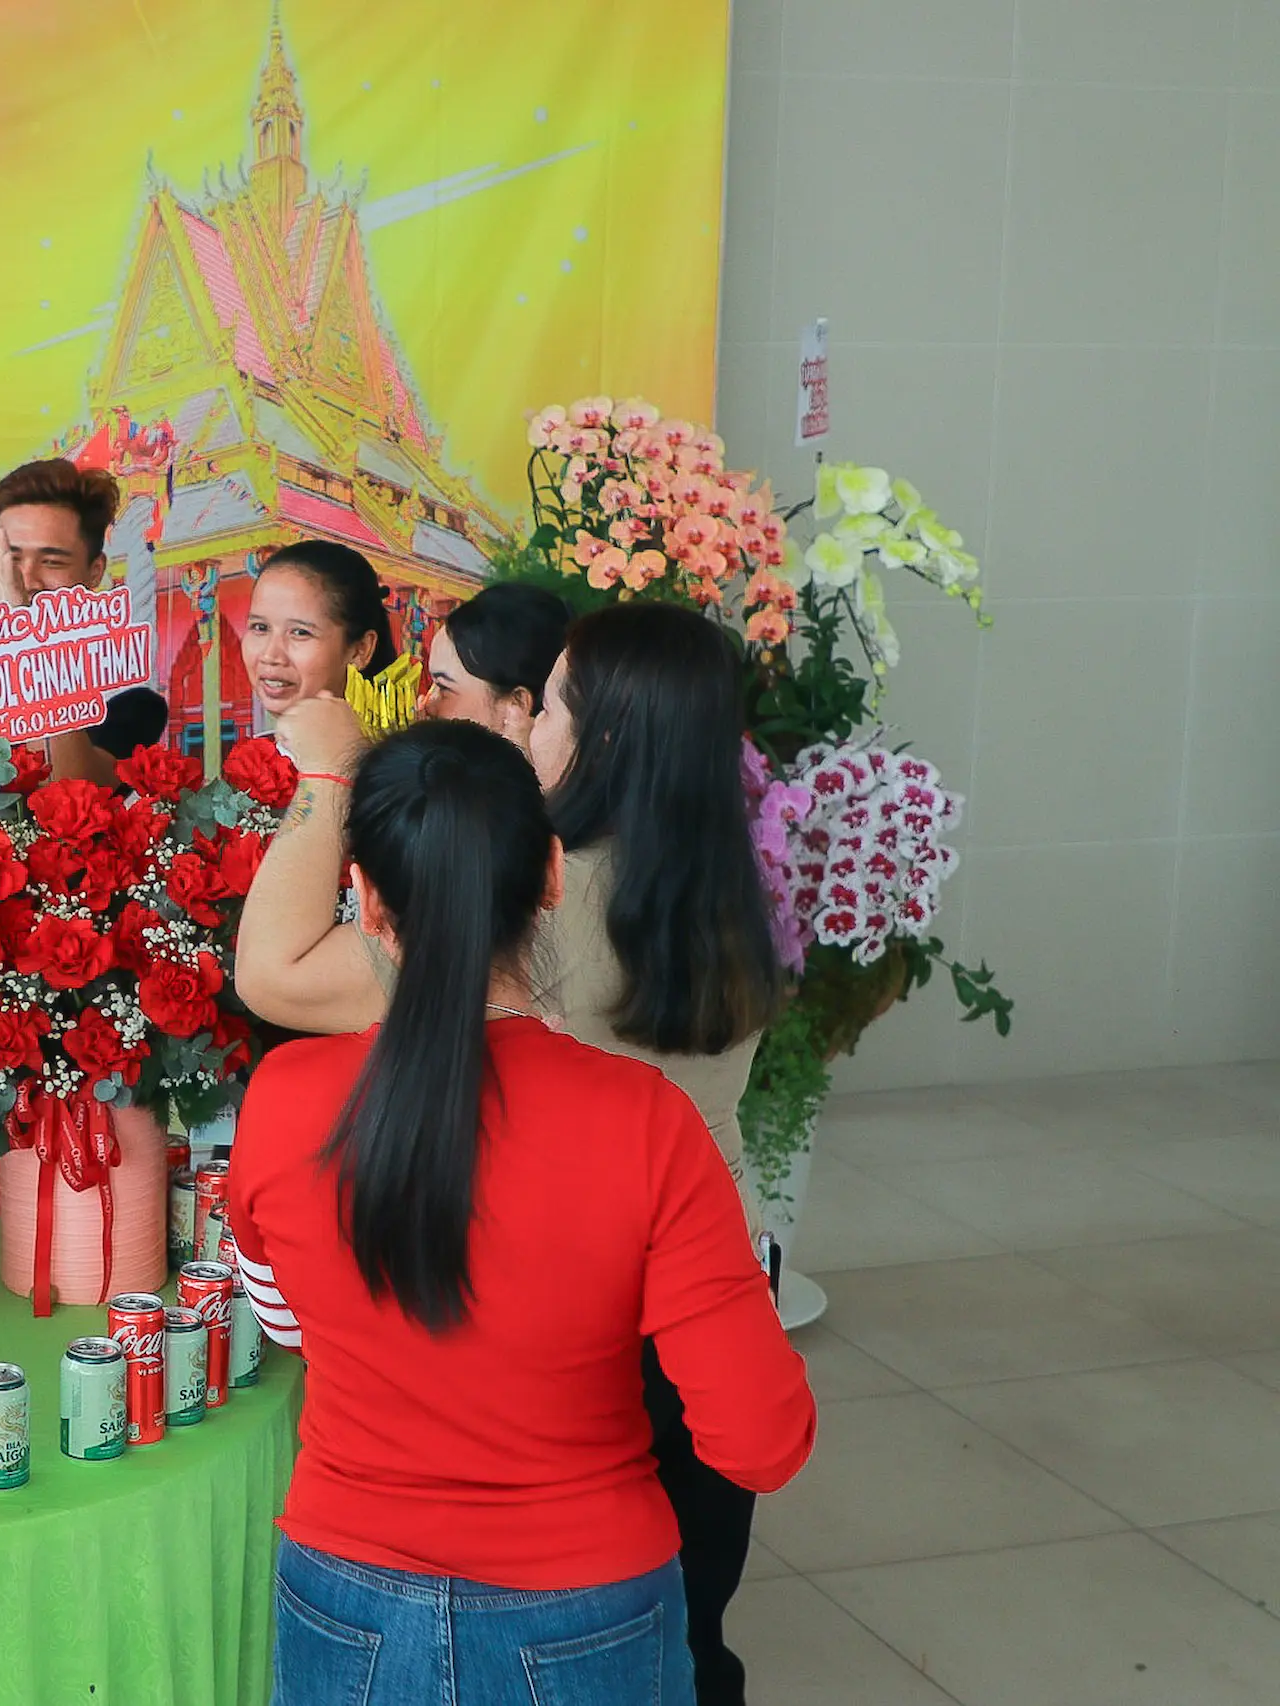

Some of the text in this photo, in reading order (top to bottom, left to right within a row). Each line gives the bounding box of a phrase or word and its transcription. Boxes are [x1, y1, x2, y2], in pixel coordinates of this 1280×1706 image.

[38, 590, 126, 638] Mừng
[18, 643, 87, 703] CHNAM
[87, 630, 148, 689] THMAY
[6, 1441, 21, 1450] BIA
